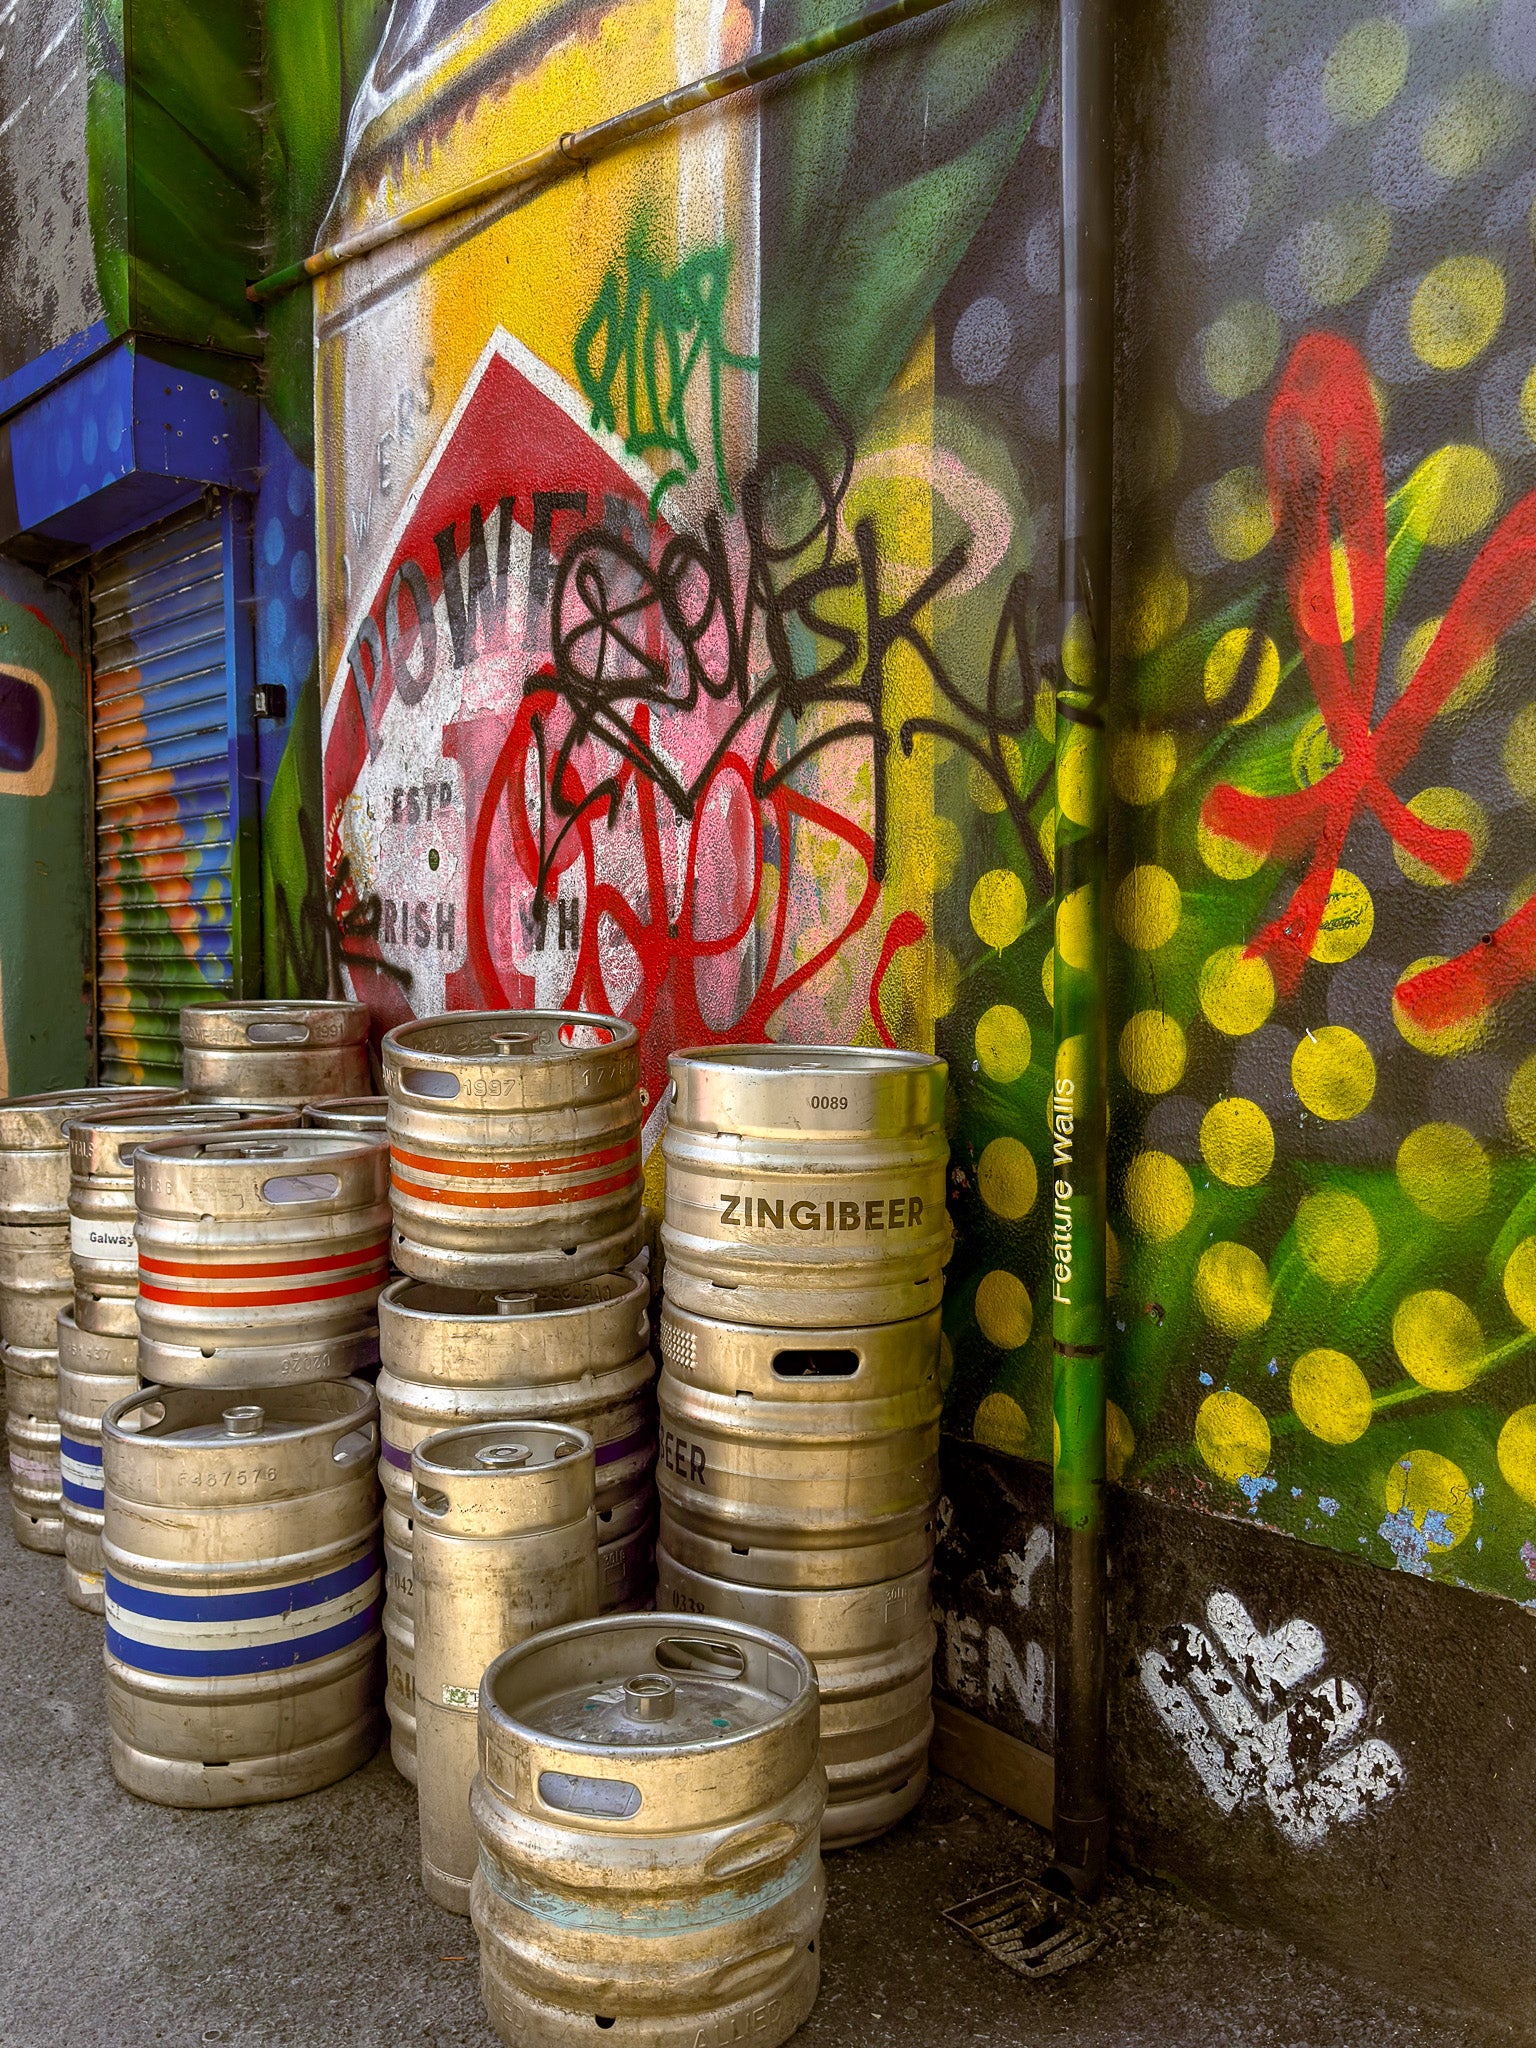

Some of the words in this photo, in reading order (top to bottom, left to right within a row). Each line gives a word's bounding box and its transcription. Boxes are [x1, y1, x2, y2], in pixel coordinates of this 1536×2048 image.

[383, 897, 456, 951] RISH
[463, 1079, 516, 1097] 1997
[810, 1095, 848, 1110] 0089
[1053, 1077, 1075, 1168] Walls
[720, 1194, 924, 1231] ZINGIBEER
[89, 1231, 135, 1248] Galway
[1053, 1179, 1073, 1305] Feature
